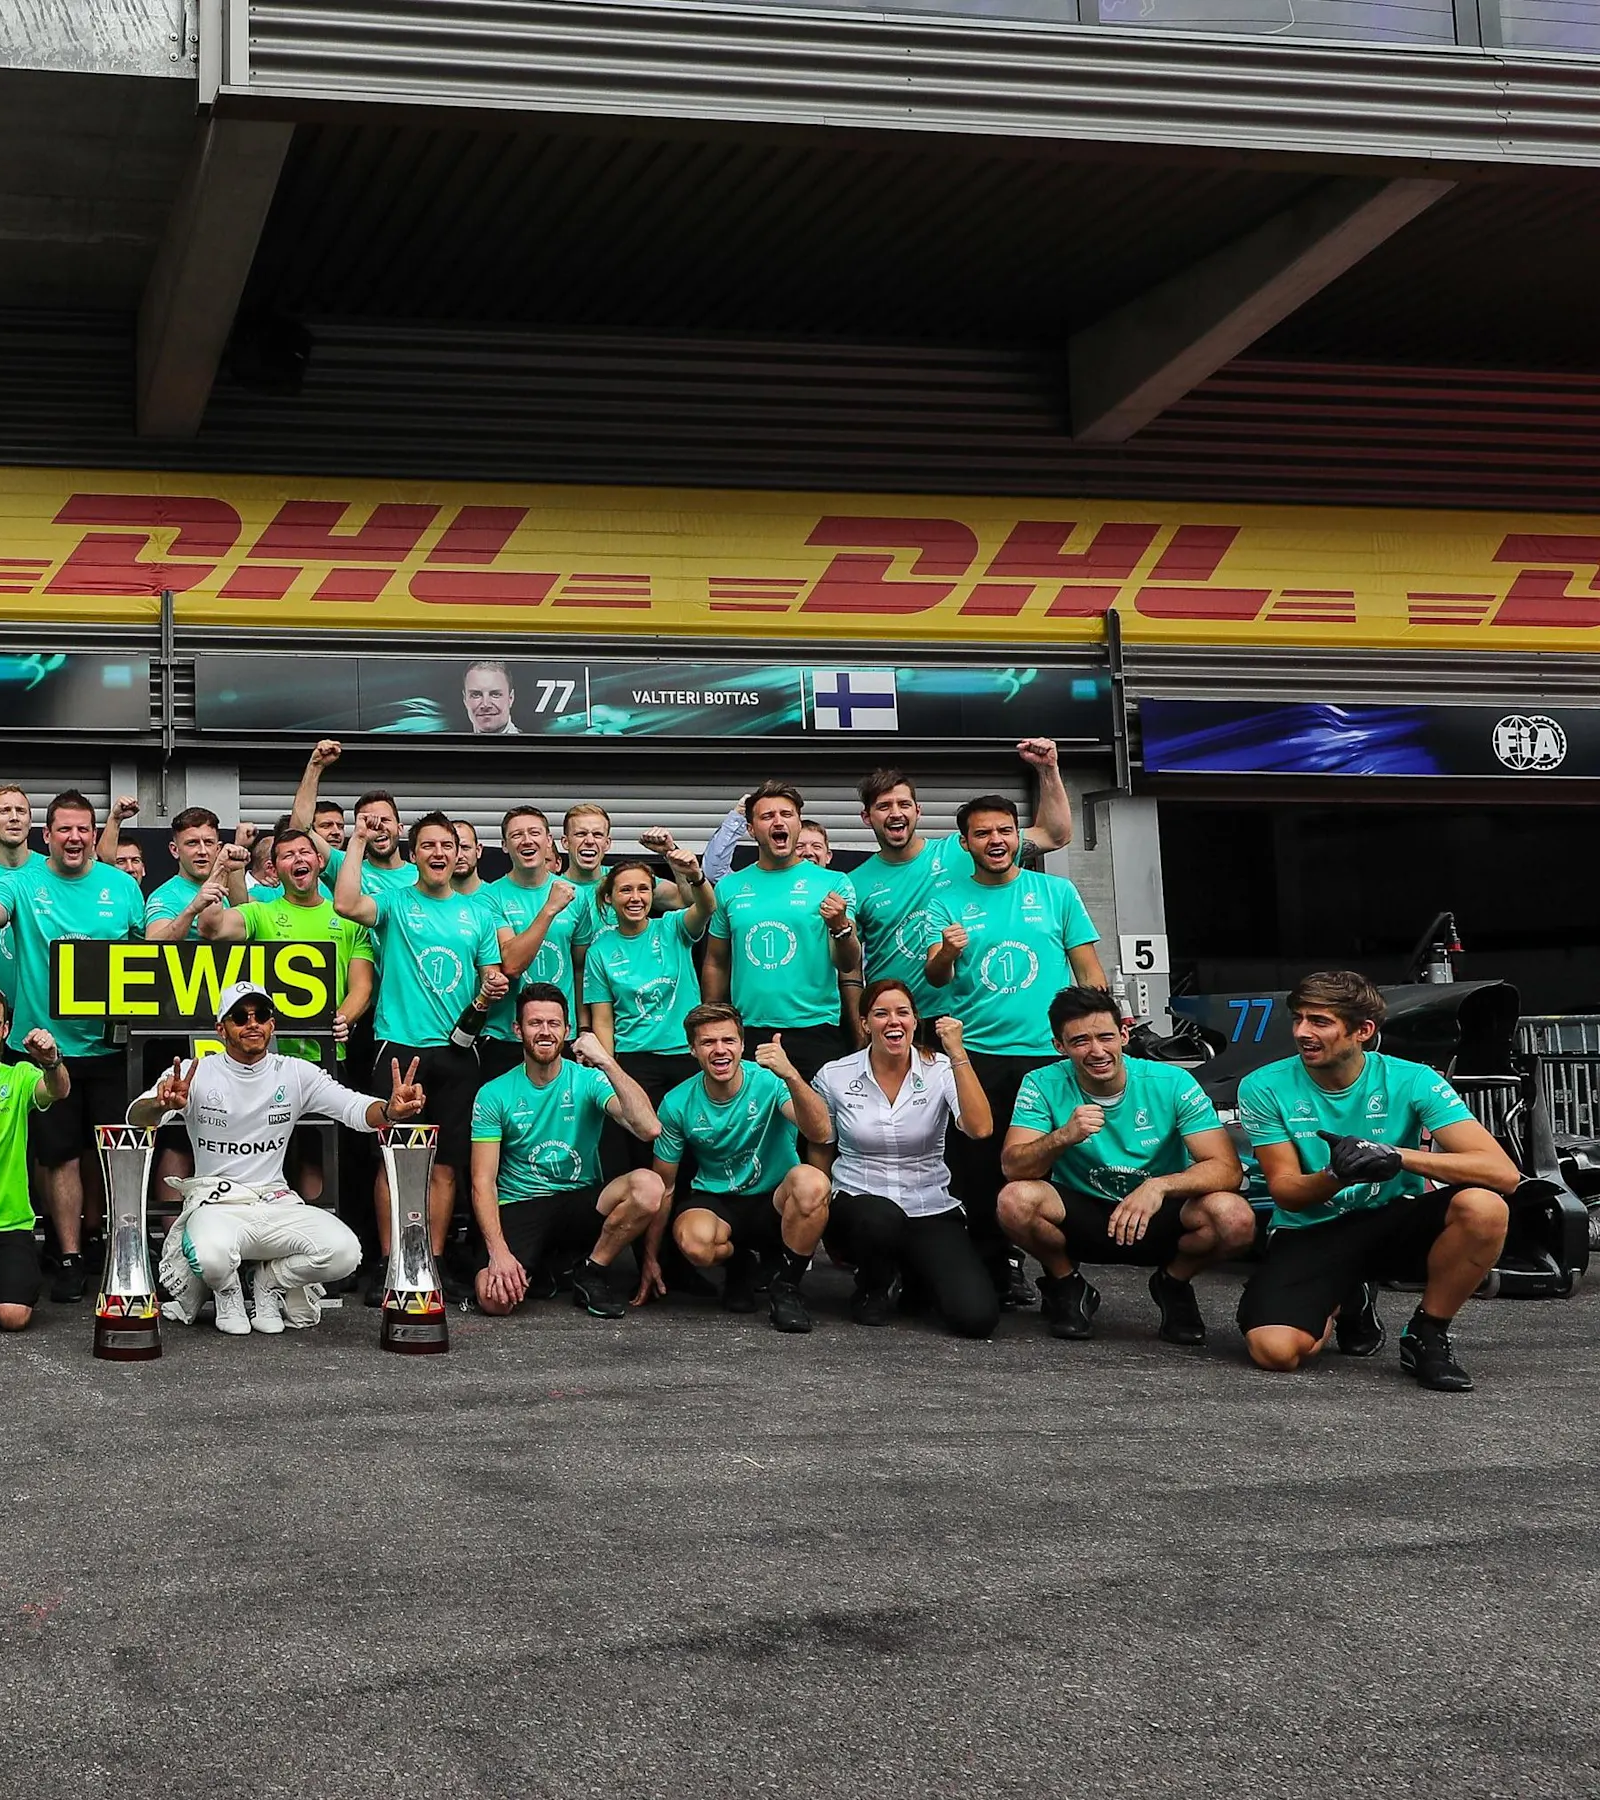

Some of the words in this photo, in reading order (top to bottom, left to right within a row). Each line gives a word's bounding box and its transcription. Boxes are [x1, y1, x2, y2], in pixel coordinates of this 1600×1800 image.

[42, 494, 561, 606] DHL
[798, 515, 1272, 622] DHL
[534, 680, 575, 713] 77
[632, 690, 701, 705] VALTTERI
[704, 690, 760, 706] BOTTAS
[750, 925, 758, 934] GP
[758, 920, 789, 933] WINNERS
[761, 931, 774, 959] 1
[998, 940, 1029, 952] WINNERS
[1135, 940, 1155, 969] 5
[536, 949, 546, 977] 1
[918, 953, 928, 961] 20
[999, 951, 1013, 982] 1
[59, 943, 328, 1019] LEWIS
[431, 956, 443, 985] 1
[1000, 986, 1017, 994] 2017
[1228, 998, 1273, 1043] 77
[208, 1117, 228, 1128] UBS
[270, 1113, 291, 1123] BOSS
[197, 1137, 285, 1155] PETRONAS
[1141, 1137, 1160, 1147] BOSS
[1302, 1131, 1317, 1139] UBS
[532, 1143, 541, 1155] GP
[541, 1139, 570, 1152] WINNERS
[545, 1150, 561, 1178] 1
